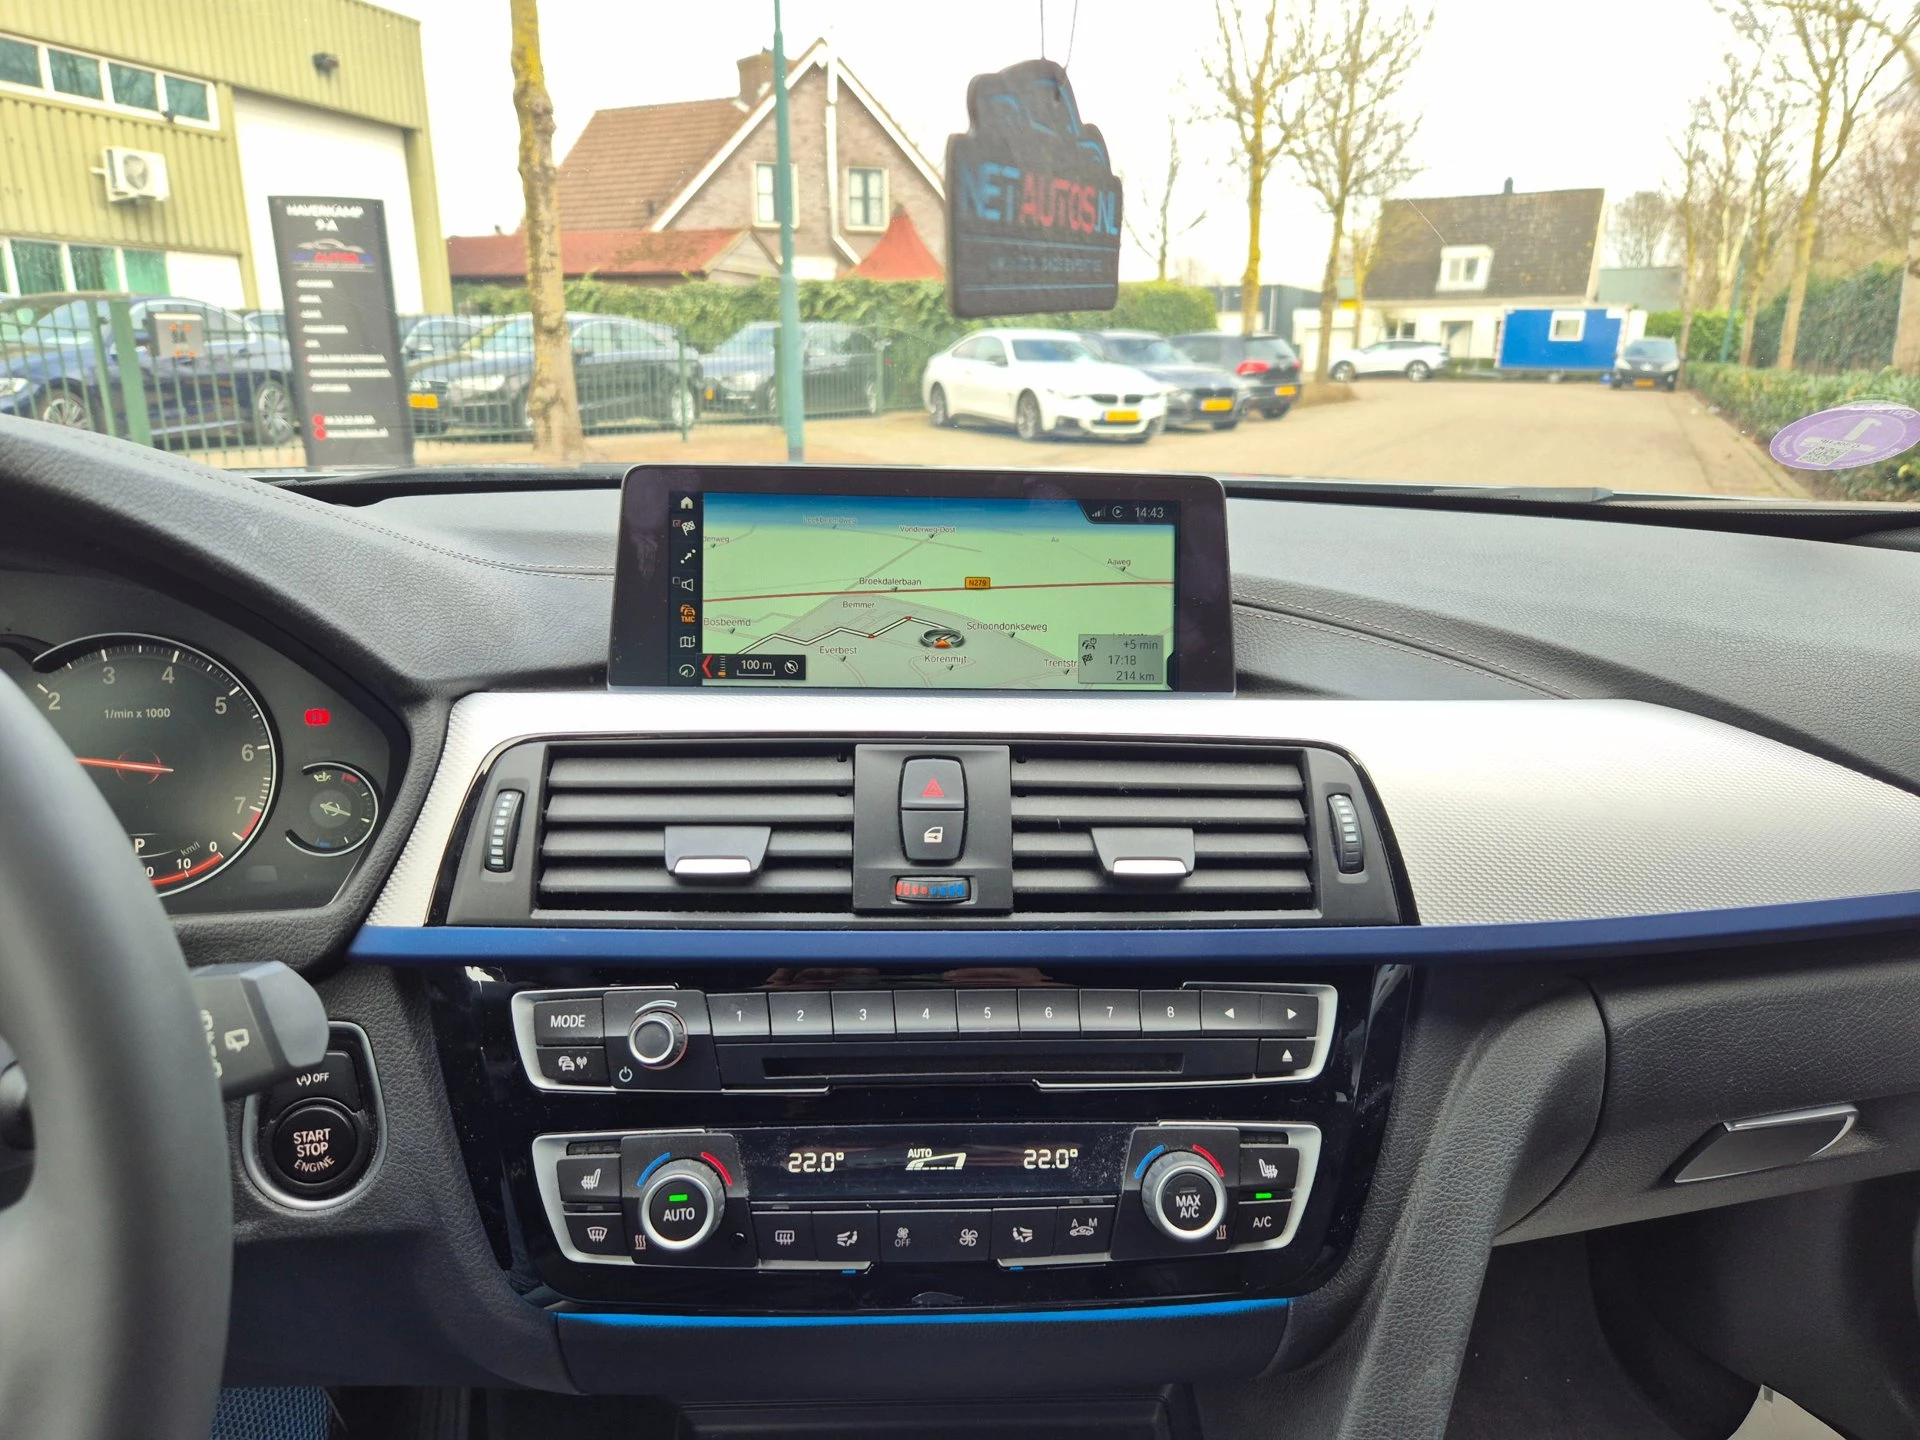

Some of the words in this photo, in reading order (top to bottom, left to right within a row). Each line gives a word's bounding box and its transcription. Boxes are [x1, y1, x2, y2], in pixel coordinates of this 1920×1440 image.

[1134, 507, 1164, 519] 14:43
[1107, 558, 1131, 567] Aaweg
[859, 577, 922, 586] Broekdalerbaan
[968, 579, 987, 587] N279
[842, 600, 875, 609] Bemmer
[703, 618, 751, 627] Bosbeemd
[966, 621, 1048, 632] Schoondonkseweg
[819, 645, 857, 654] Everbest
[1123, 640, 1136, 650] +5
[1139, 640, 1158, 650] min
[741, 660, 760, 670] 100
[762, 662, 772, 670] m
[924, 655, 967, 664] Korenmijt
[1044, 659, 1078, 667] Trentstr
[1108, 655, 1137, 665] 17:18
[103, 667, 116, 684] 3
[161, 666, 175, 684] 4
[1116, 671, 1135, 681] 214
[1139, 671, 1155, 681] km
[47, 692, 61, 711] 2
[214, 696, 227, 715] 5
[104, 709, 134, 719] 1/min
[136, 711, 143, 719] x
[145, 707, 171, 719] 1000
[241, 744, 255, 762] 6
[234, 797, 246, 815] 7
[134, 838, 146, 853] P
[209, 841, 217, 853] 0
[176, 858, 191, 870] 10
[736, 1010, 742, 1022] 1
[796, 1010, 805, 1022] 2
[859, 1008, 867, 1021] 3
[922, 1007, 930, 1020] 4
[984, 1007, 991, 1019] 5
[1045, 1007, 1053, 1019] 6
[1106, 1006, 1114, 1018] 7
[1166, 1006, 1175, 1018] 8
[550, 1014, 586, 1028] MODE
[312, 1072, 330, 1083] OFF
[293, 1128, 331, 1145] START
[296, 1141, 329, 1158] STOP
[907, 1147, 933, 1159] AUTO
[294, 1154, 335, 1173] ENGINE
[1175, 1194, 1201, 1208] MAX
[663, 1207, 695, 1222] AUTO
[1180, 1206, 1199, 1219] A/C
[1071, 1218, 1078, 1227] A
[1088, 1217, 1098, 1227] M
[1252, 1216, 1272, 1228] A/C
[894, 1238, 911, 1248] OFF
